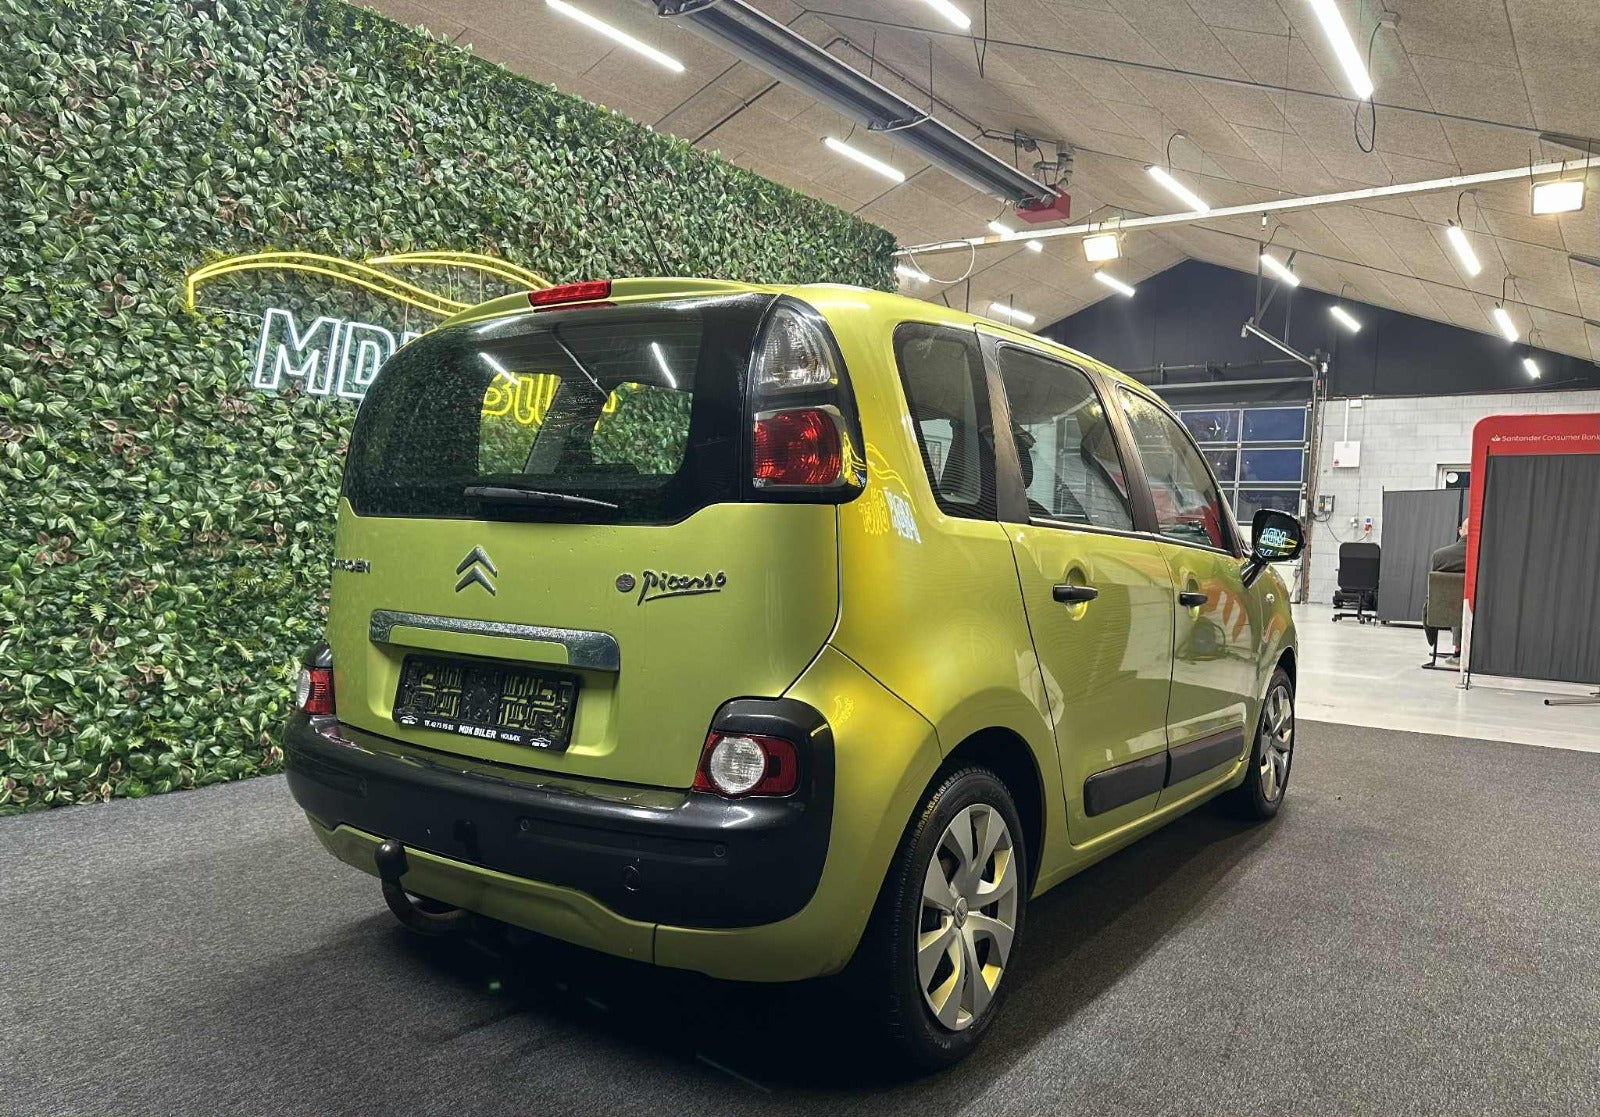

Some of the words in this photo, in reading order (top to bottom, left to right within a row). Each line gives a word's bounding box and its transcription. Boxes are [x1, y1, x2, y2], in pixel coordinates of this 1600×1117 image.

[253, 307, 421, 399] MD
[637, 570, 727, 607] Picasso
[458, 724, 474, 735] MDK
[474, 727, 497, 739] BILER
